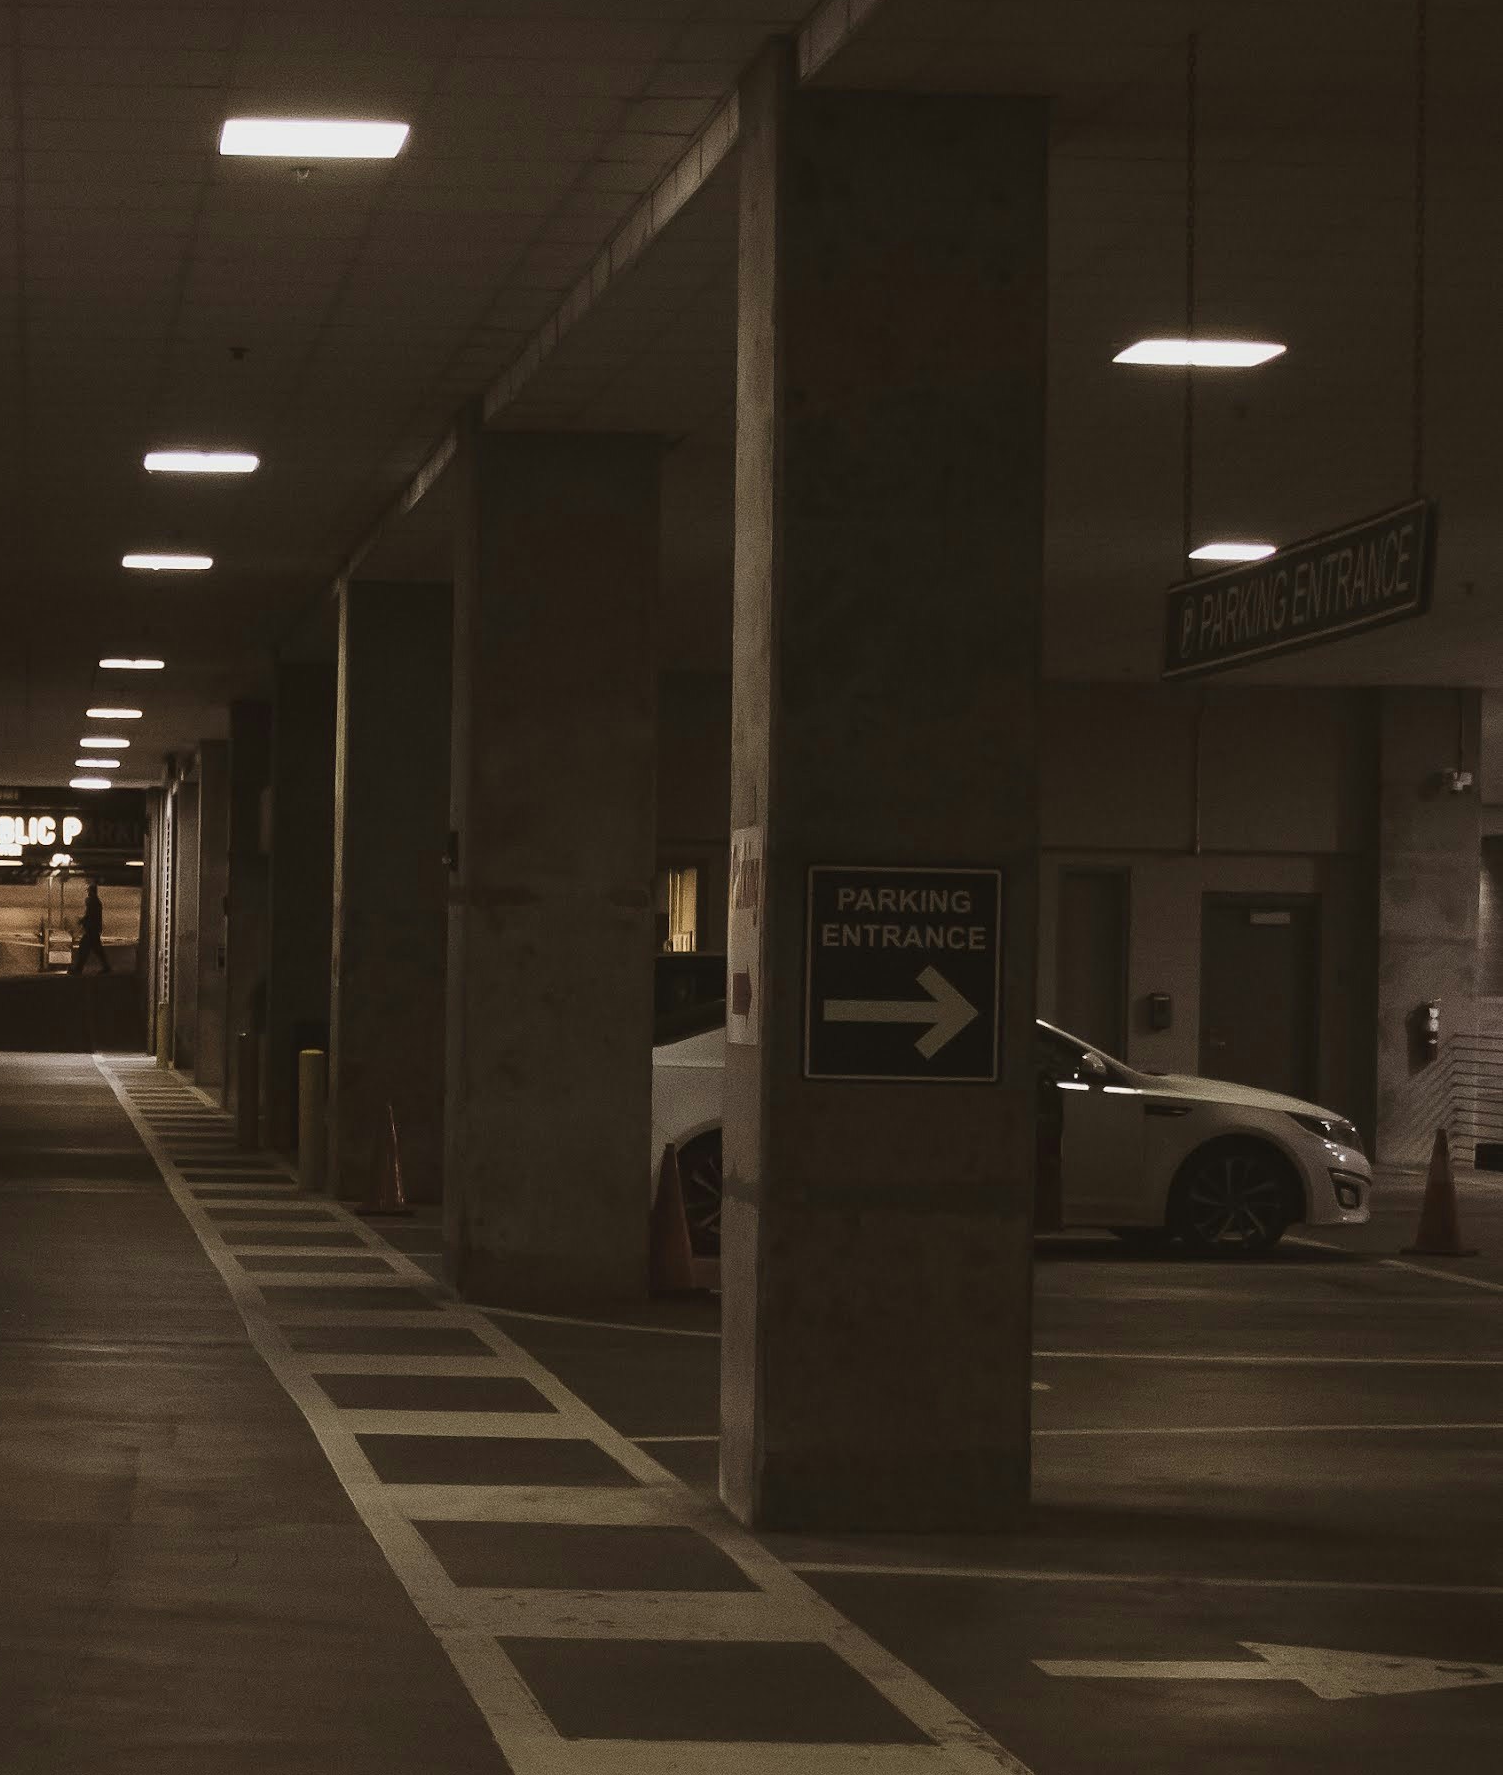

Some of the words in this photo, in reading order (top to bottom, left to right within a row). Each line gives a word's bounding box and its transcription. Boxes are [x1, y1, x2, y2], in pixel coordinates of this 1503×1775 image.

[1199, 570, 1287, 650] PARKING
[1291, 524, 1413, 625] ENTRANCE
[837, 887, 972, 913] PARKING
[821, 923, 987, 950] ENTRANCE
